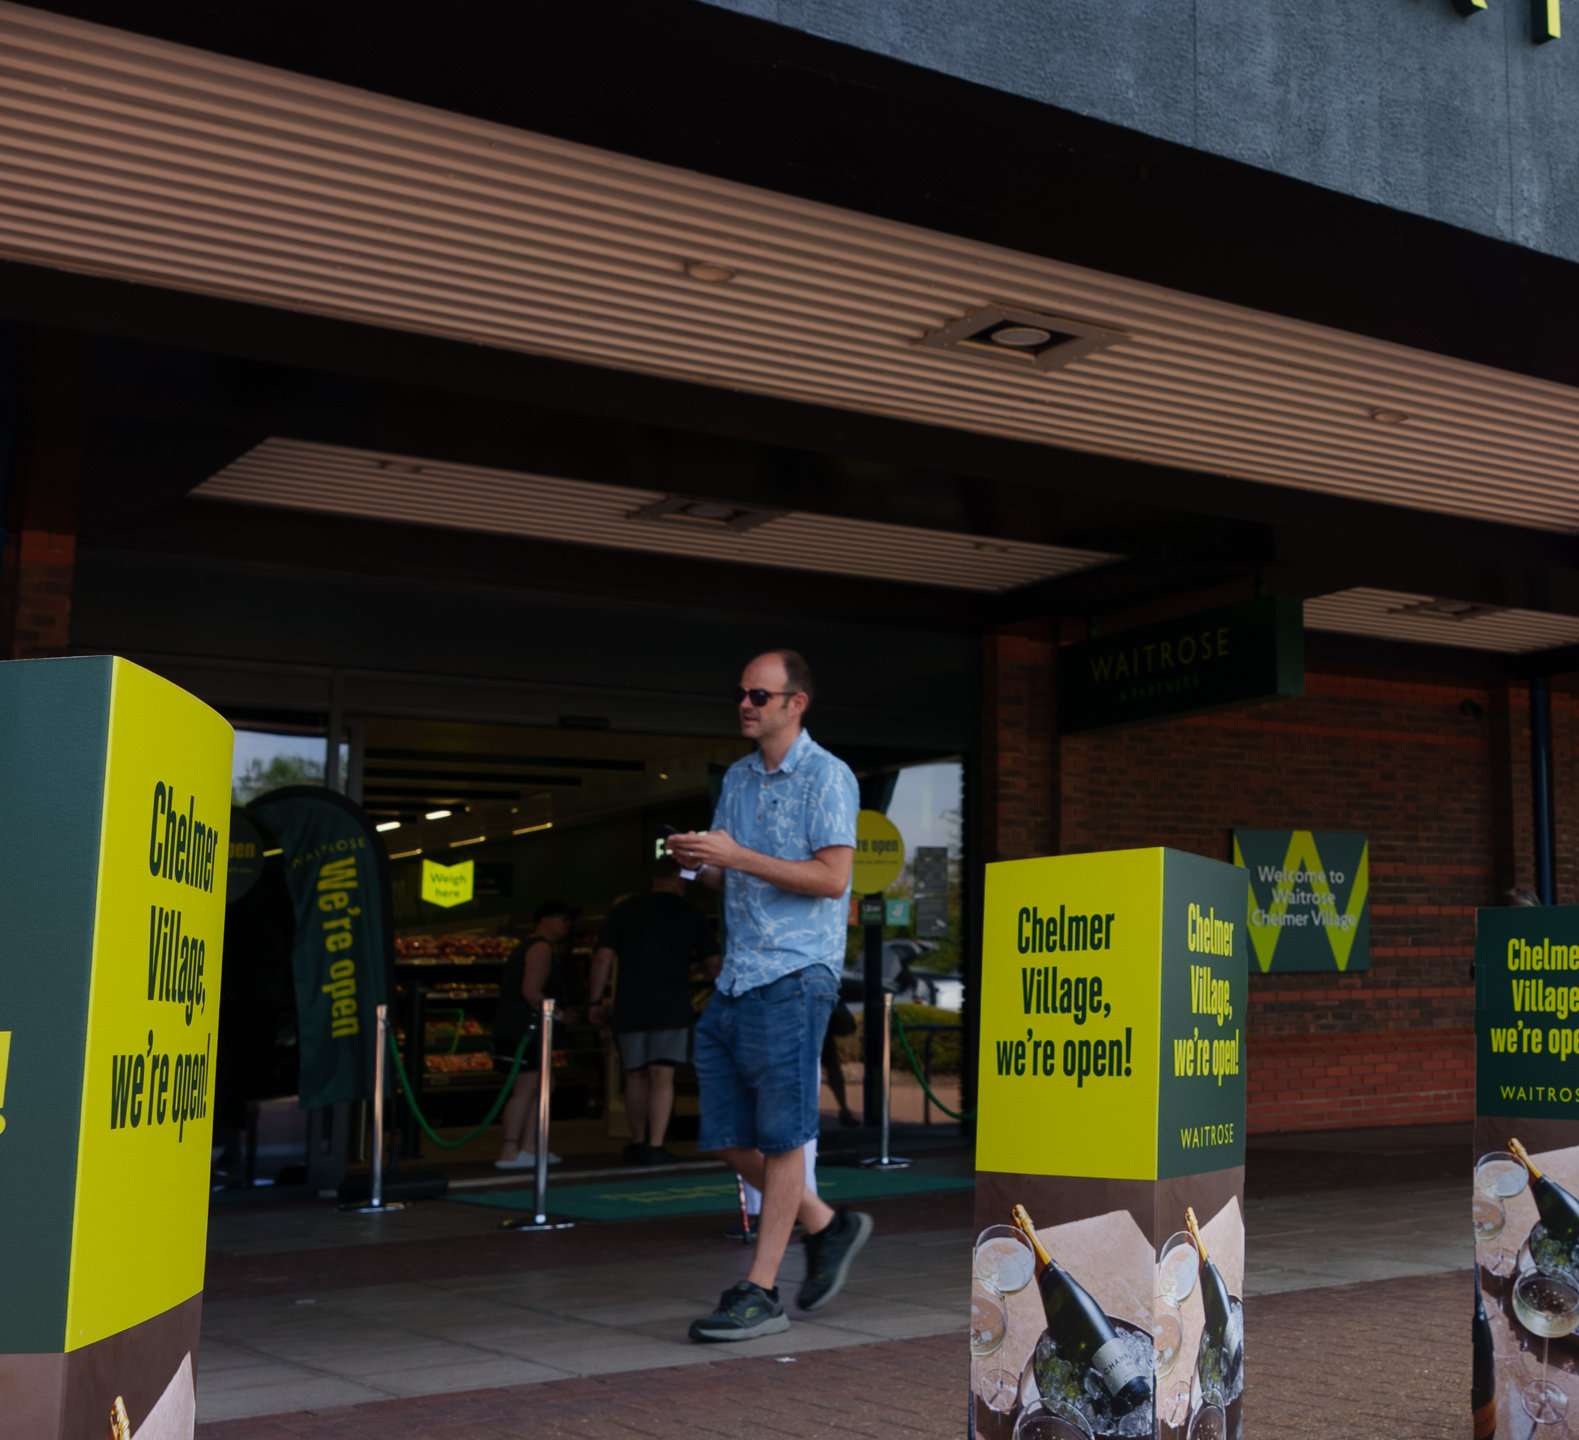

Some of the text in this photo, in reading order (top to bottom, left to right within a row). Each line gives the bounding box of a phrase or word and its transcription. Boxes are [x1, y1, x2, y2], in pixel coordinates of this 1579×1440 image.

[1088, 625, 1232, 685] WAITROSE
[1129, 673, 1201, 701] PARTNERS
[149, 780, 218, 894] Chelmer
[430, 873, 466, 886] Weigh
[434, 888, 460, 898] here
[1257, 864, 1345, 884] Welcome to
[1271, 887, 1336, 905] Waitrose
[1018, 904, 1115, 954] Chelmer
[1187, 902, 1234, 957] Chelmer
[1251, 908, 1356, 931] Chelmer Village
[146, 904, 206, 1027] Village,
[321, 958, 360, 1039] open
[1022, 966, 1111, 1025] Village,
[1190, 964, 1233, 1027] Village,
[1063, 1027, 1132, 1088] open!
[1212, 1028, 1240, 1087] open!
[172, 1032, 212, 1144] open!
[1180, 1123, 1234, 1149] WAITROSE
